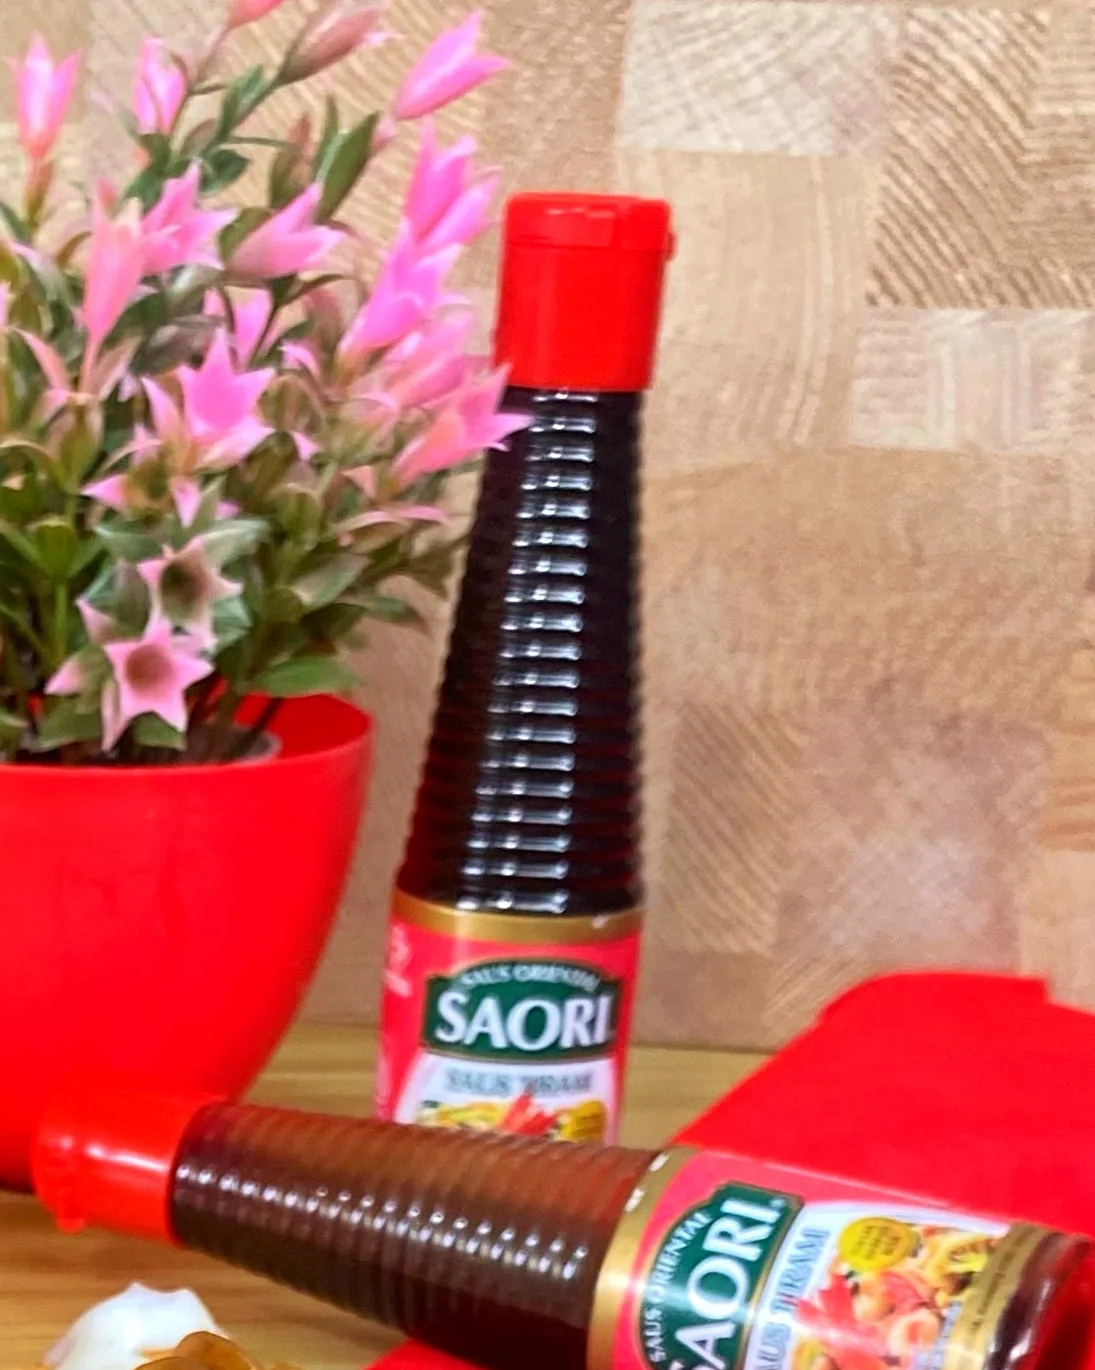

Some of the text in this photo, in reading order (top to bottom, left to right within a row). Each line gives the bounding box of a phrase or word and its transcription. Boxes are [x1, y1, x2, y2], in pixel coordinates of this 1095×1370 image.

[435, 991, 613, 1051] SAORI
[445, 1068, 509, 1096] SAUS
[644, 1212, 713, 1363] SAUS ORIENTAL
[770, 1228, 830, 1315] TIRAM
